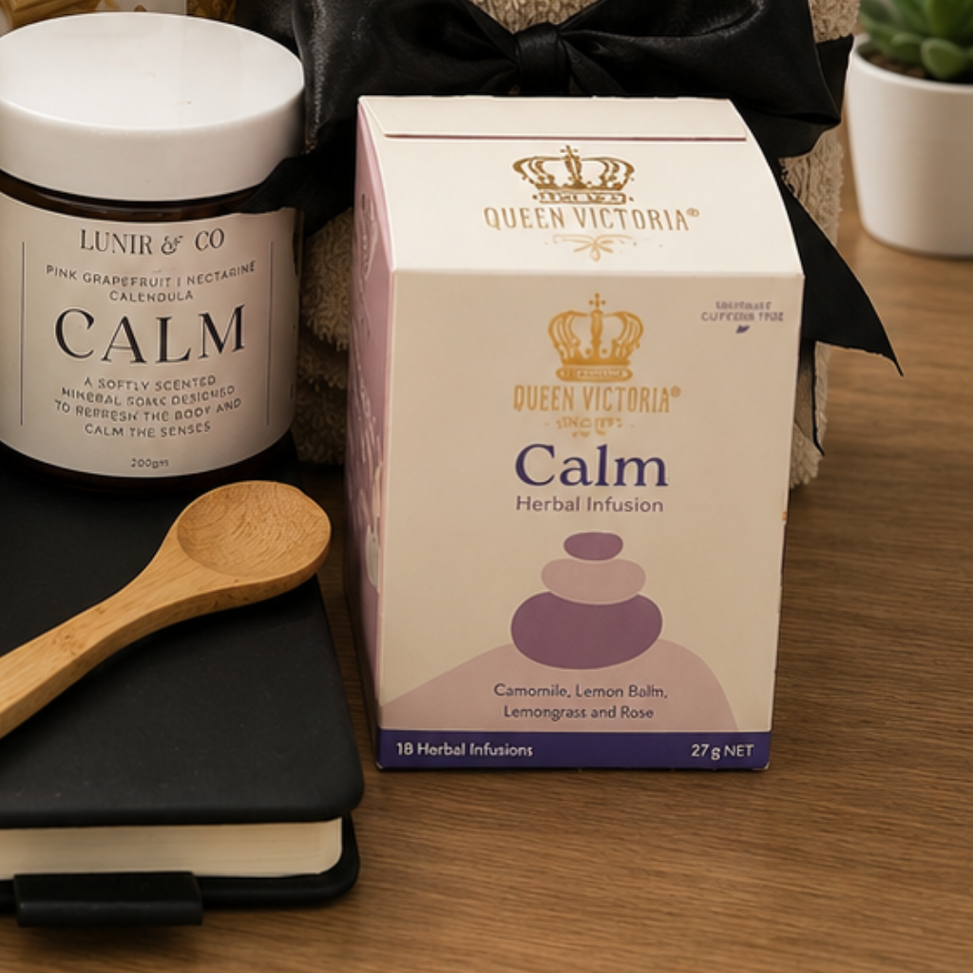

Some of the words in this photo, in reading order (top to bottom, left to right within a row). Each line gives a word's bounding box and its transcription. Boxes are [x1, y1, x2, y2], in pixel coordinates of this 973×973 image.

[483, 207, 565, 230] QUEEN
[195, 228, 225, 252] CO
[46, 264, 77, 281] PINK
[82, 272, 171, 288] GRAPEFRUIT
[186, 260, 257, 285] NECTARINE
[54, 304, 245, 364] CALM
[83, 377, 93, 387] A
[215, 397, 243, 414] AND
[513, 384, 575, 413] QUEEN
[84, 423, 124, 437] CALM
[514, 443, 669, 487] Calm
[516, 495, 581, 513] Herbal
[586, 495, 665, 513] Infusion
[576, 683, 624, 698] Lemon
[504, 704, 586, 722] Lemongrass
[590, 706, 617, 719] and
[620, 705, 655, 719] Rose
[417, 742, 466, 757] Herbal
[469, 743, 534, 758] Infusions
[724, 744, 755, 758] NET
